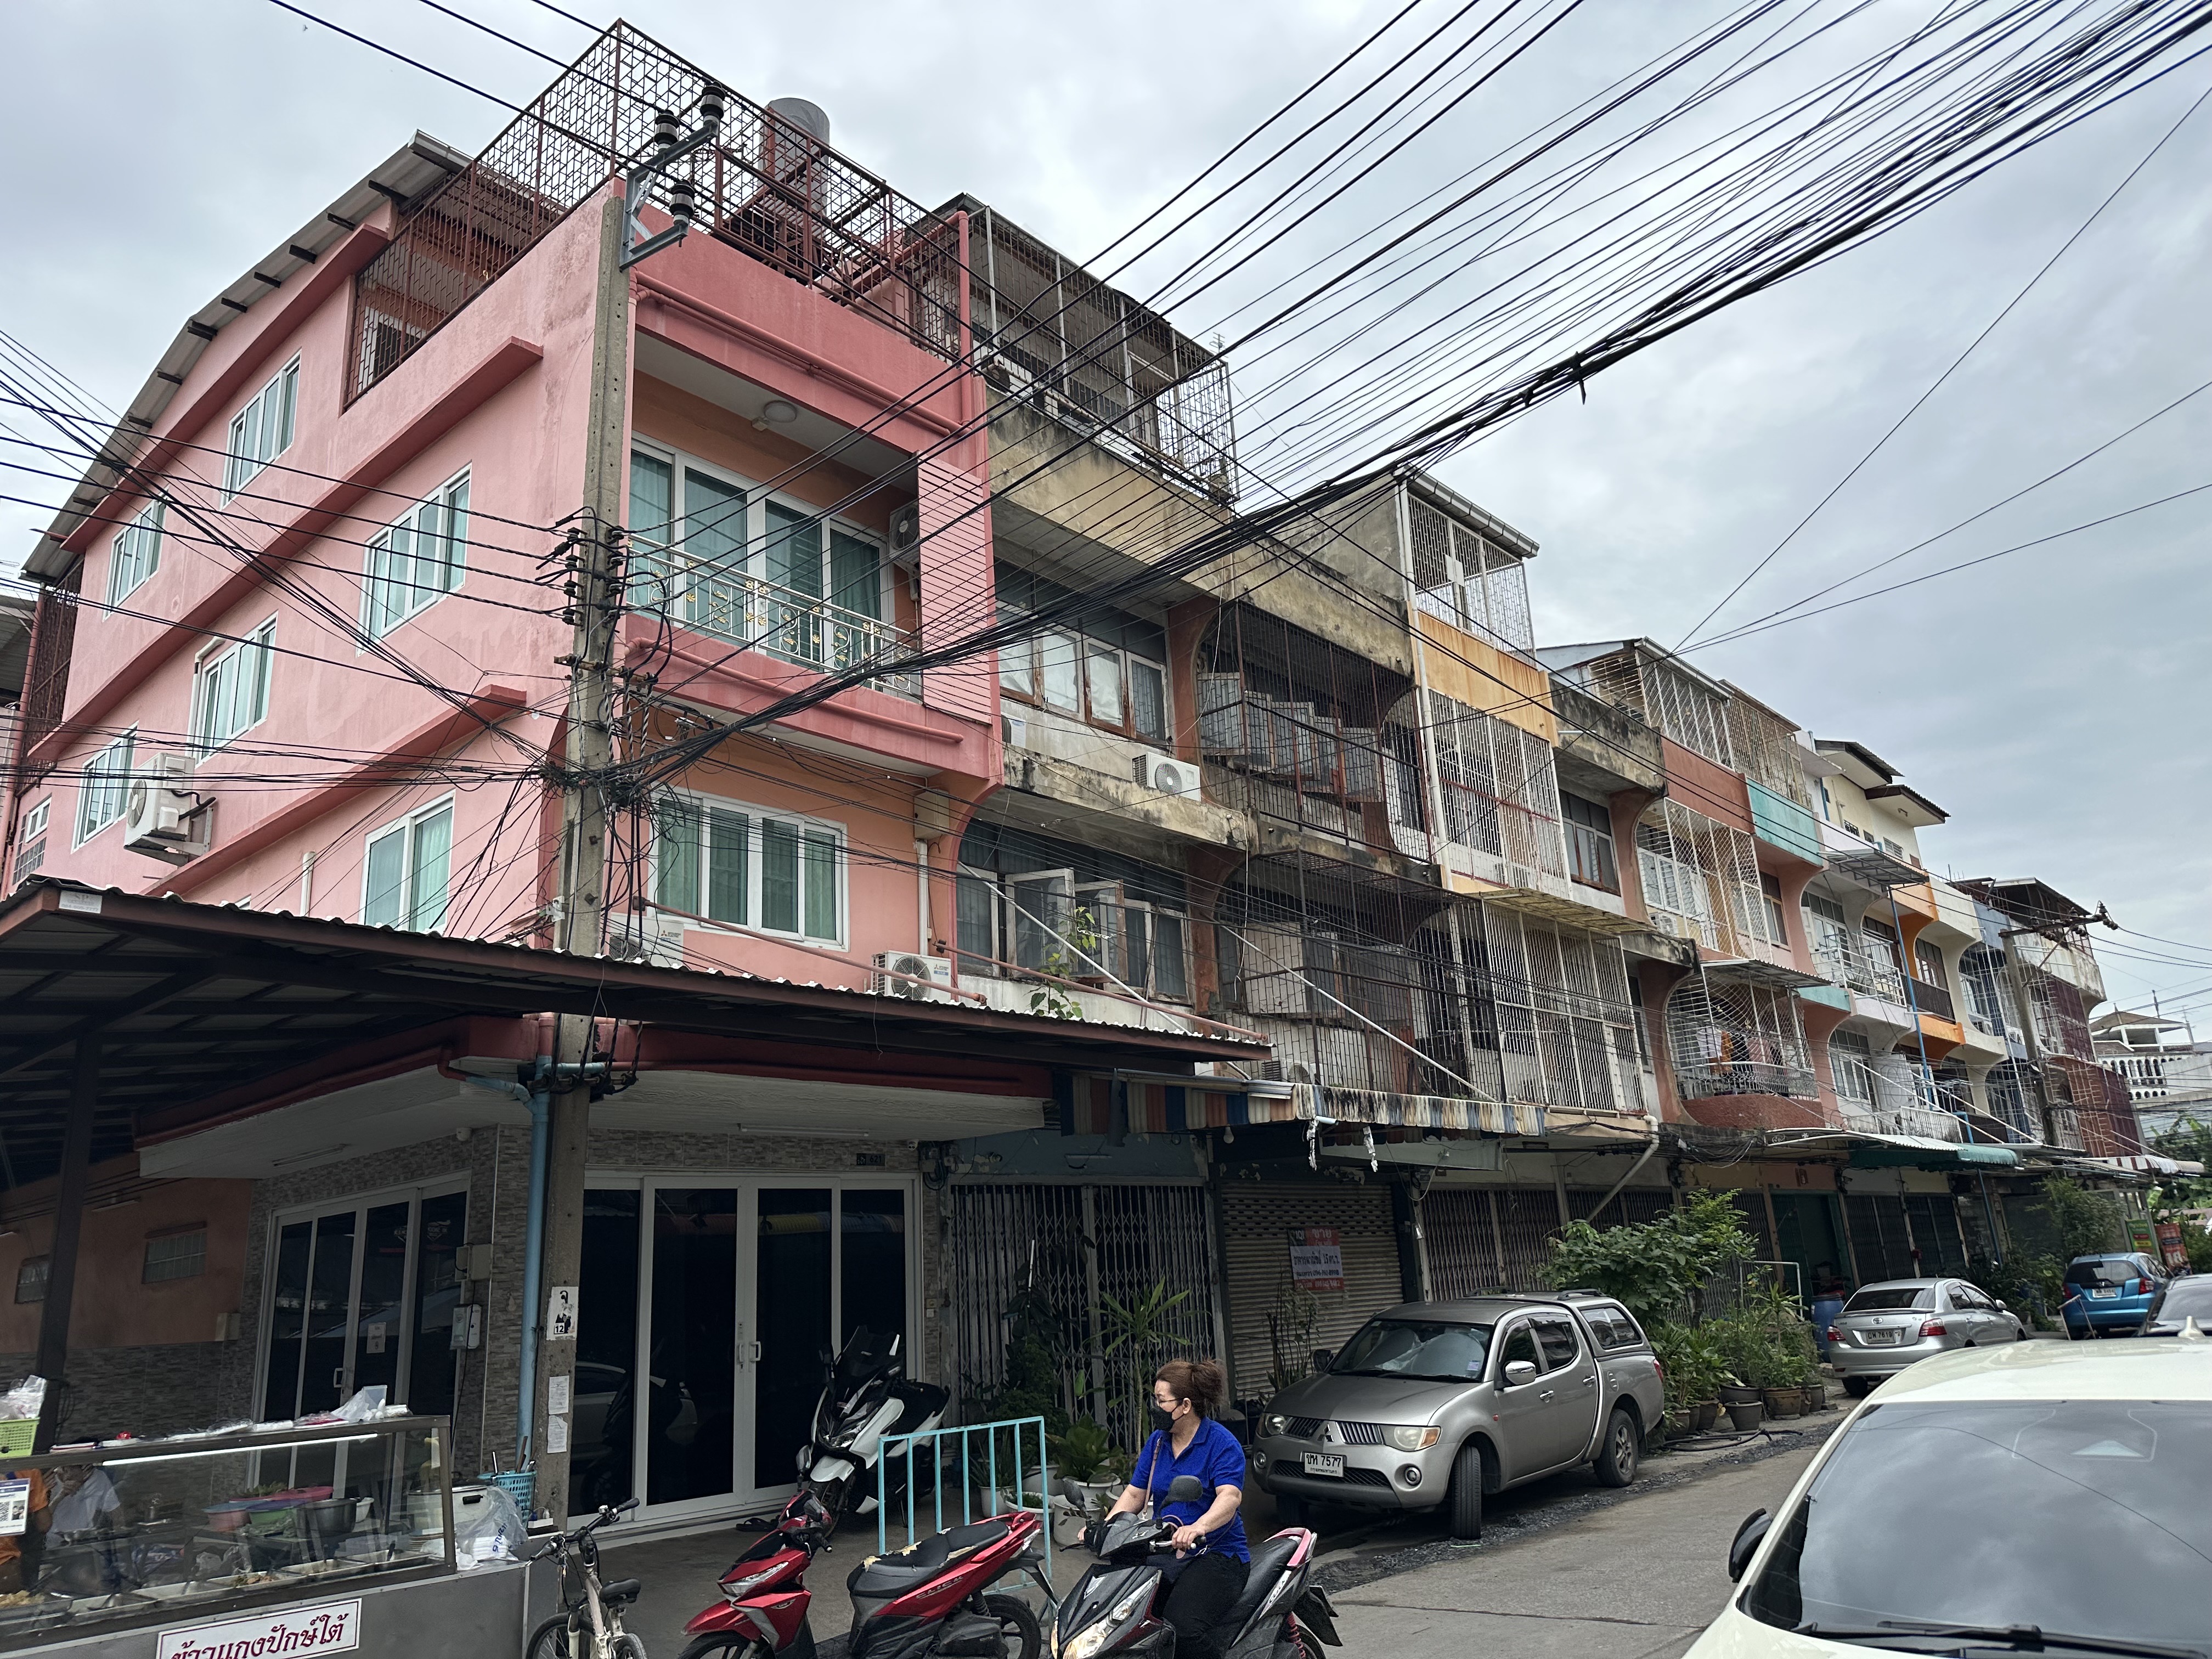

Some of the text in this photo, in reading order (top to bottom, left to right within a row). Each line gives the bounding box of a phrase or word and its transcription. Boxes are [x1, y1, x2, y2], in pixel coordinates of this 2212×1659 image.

[1312, 1228, 1332, 1238] ขาย
[555, 1325, 564, 1333] 12
[1321, 1455, 1342, 1468] 7577
